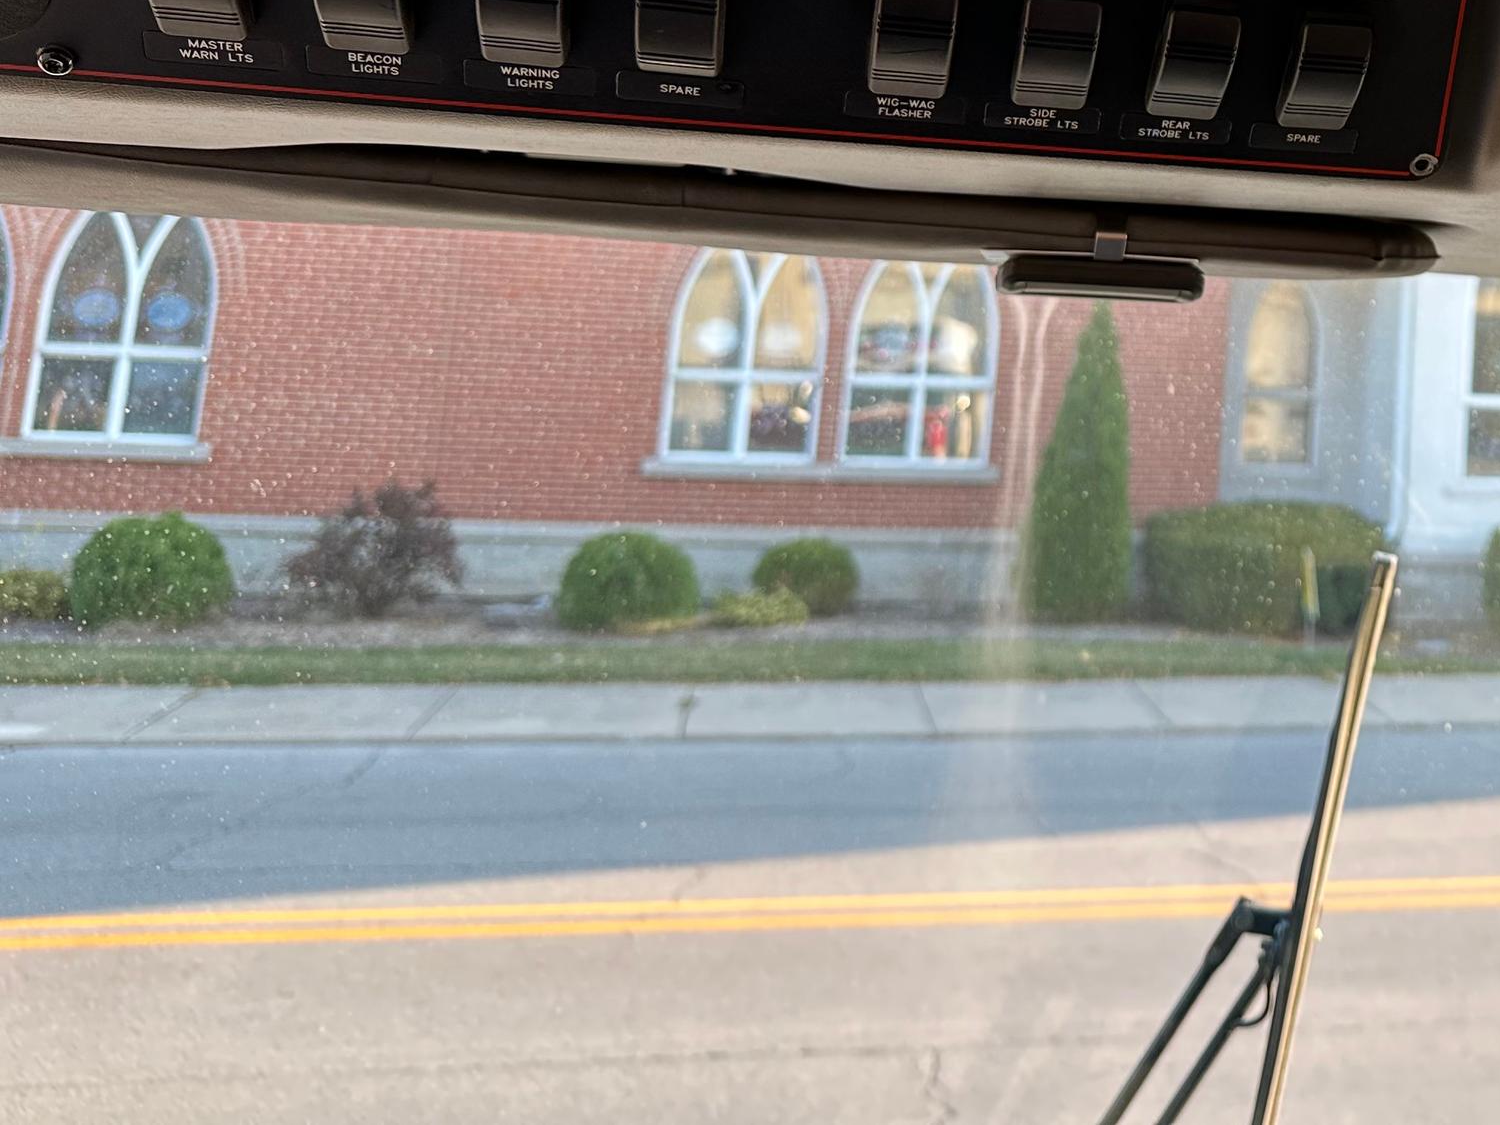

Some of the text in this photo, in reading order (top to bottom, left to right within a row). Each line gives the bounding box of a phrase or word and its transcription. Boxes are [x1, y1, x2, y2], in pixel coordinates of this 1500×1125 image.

[187, 39, 244, 52] MASTER
[179, 48, 254, 63] WARN LTS
[347, 52, 402, 66] BEACON
[351, 63, 400, 76] LIGHTS
[500, 65, 560, 79] WARNING
[507, 78, 554, 91] LIGHTS
[659, 83, 701, 96] SPARE
[876, 96, 936, 109] WIG-WAG
[878, 107, 932, 119] FLASHER
[1029, 108, 1057, 118] SIDE
[1004, 116, 1079, 130] STROBE LTS
[1161, 119, 1191, 130] REAR
[1138, 128, 1210, 141] STROBE LTS
[1286, 133, 1322, 144] SPARE
